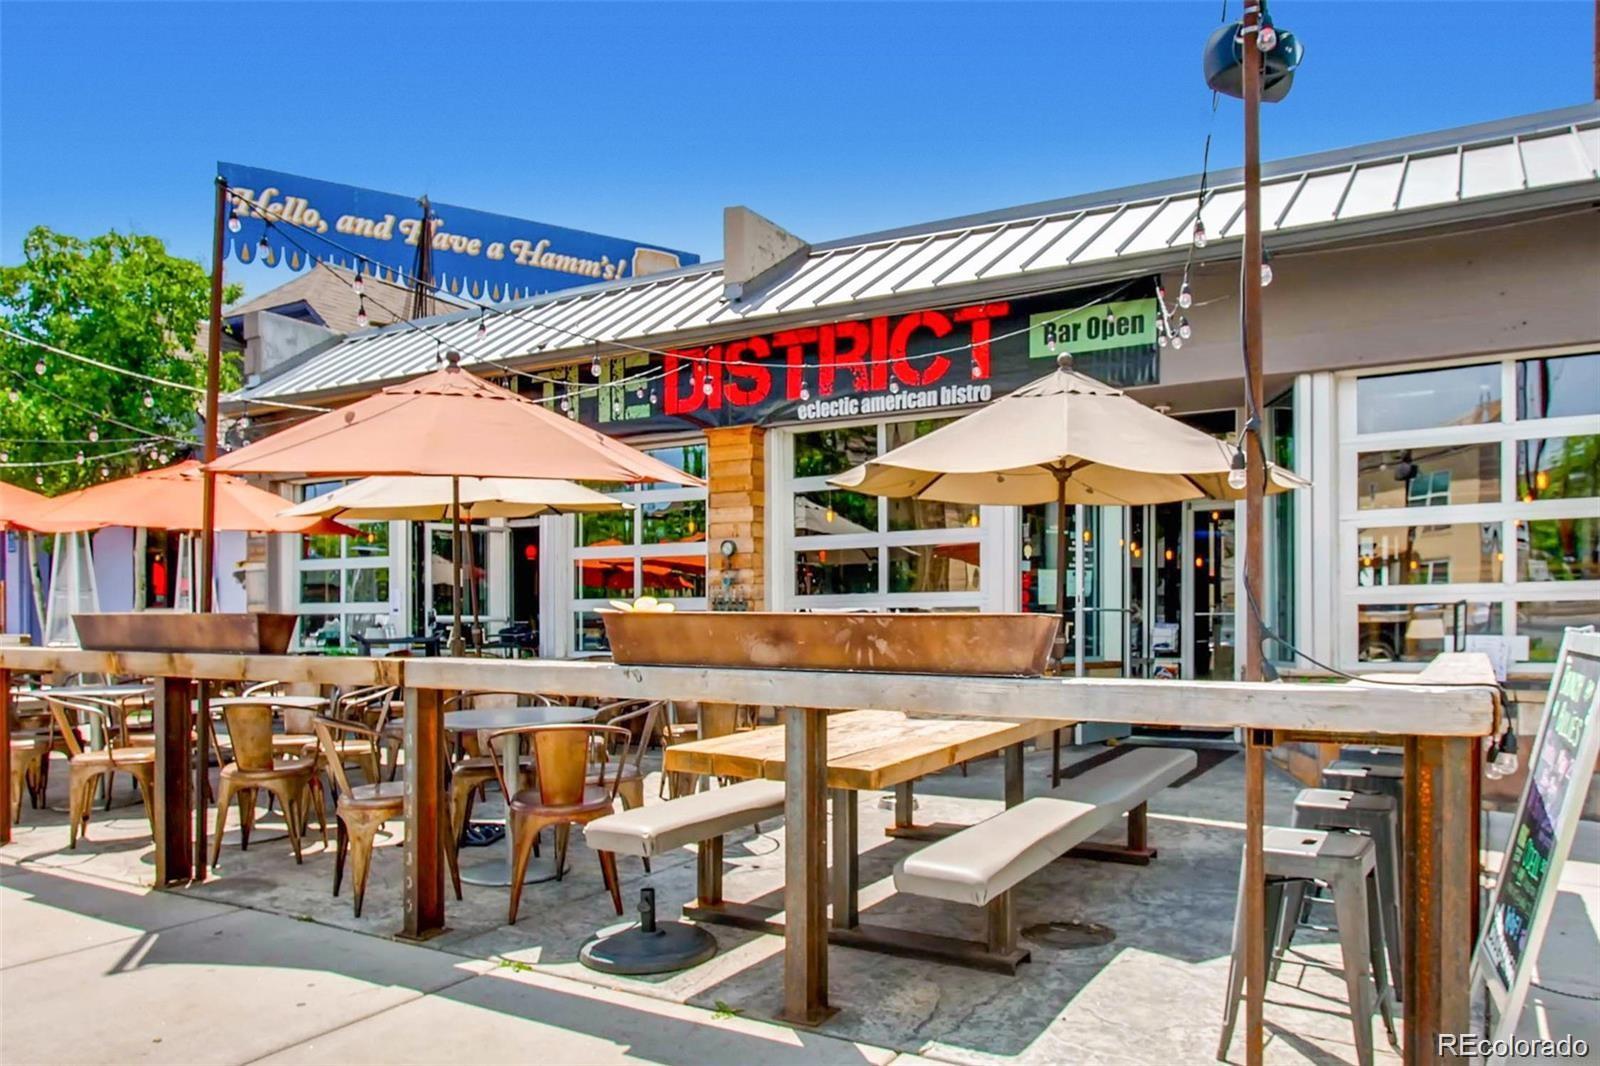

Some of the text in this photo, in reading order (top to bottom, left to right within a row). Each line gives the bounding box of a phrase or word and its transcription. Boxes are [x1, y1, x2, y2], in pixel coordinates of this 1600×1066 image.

[226, 187, 328, 234] Hello,
[336, 214, 396, 240] and
[486, 241, 505, 260] a
[509, 239, 627, 280] Hamm's!
[664, 300, 1010, 416] DISTRICT
[1043, 314, 1145, 345] Bar Open
[797, 384, 992, 420] eclectic american bistro
